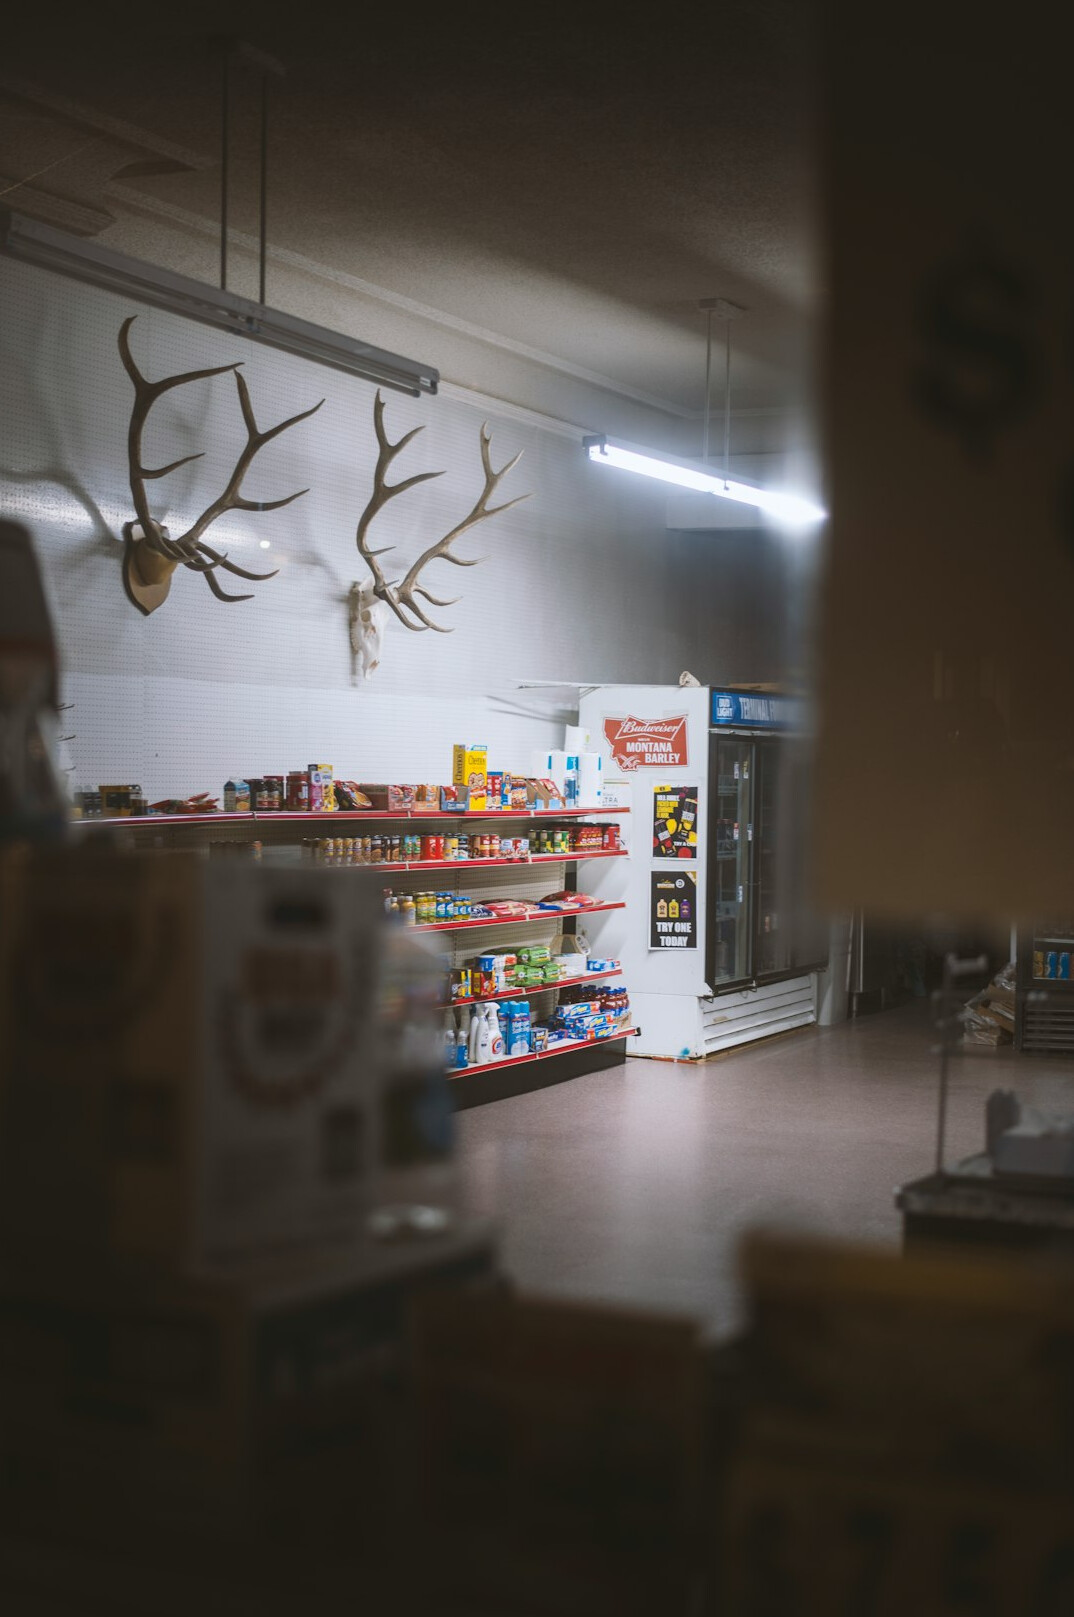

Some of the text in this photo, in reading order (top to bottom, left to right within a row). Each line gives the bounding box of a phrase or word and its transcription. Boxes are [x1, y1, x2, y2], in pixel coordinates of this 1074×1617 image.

[621, 720, 680, 733] Budweiser
[626, 741, 673, 753] MONTANA
[645, 752, 681, 764] BARLEY
[656, 921, 692, 933] TRY ONE
[660, 936, 689, 947] TODAY
